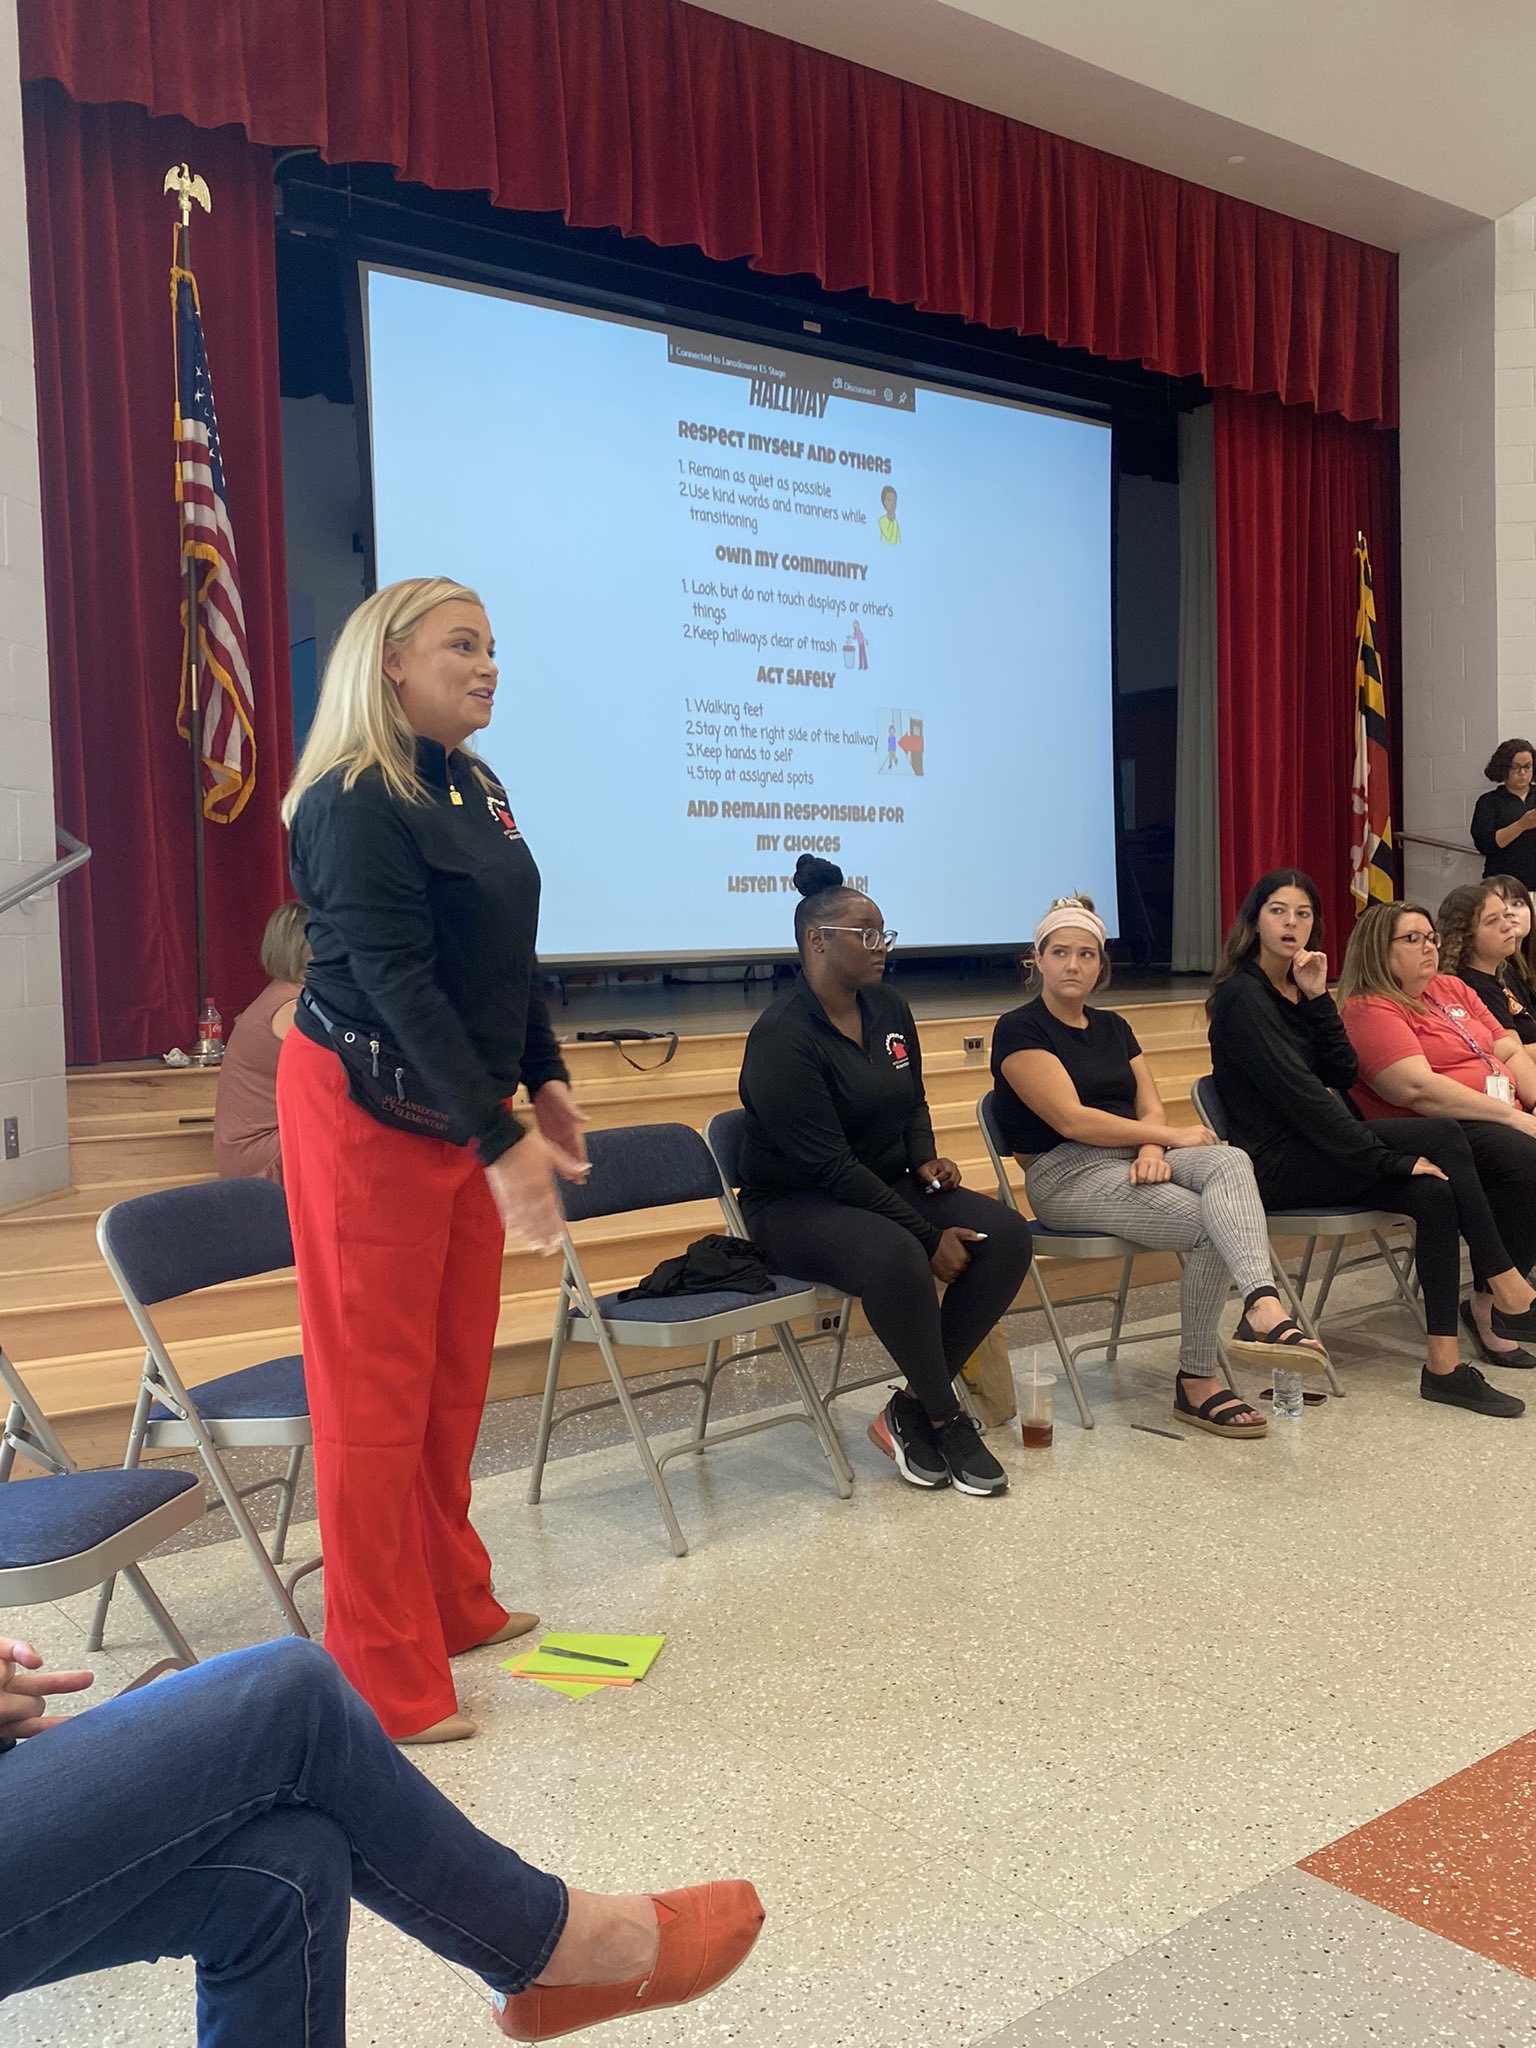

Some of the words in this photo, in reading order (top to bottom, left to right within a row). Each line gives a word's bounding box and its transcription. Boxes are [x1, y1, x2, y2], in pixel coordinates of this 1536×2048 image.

[676, 347, 712, 362] Connected
[714, 355, 721, 364] to
[722, 356, 758, 372] Lansdowne
[759, 364, 767, 374] ES
[768, 366, 786, 379] Stage
[750, 379, 830, 418] HALLWAY
[844, 382, 877, 396] Disconnect
[688, 460, 730, 481] Remain
[733, 470, 745, 484] as
[748, 470, 774, 492] quiet
[777, 478, 790, 492] as
[792, 478, 832, 498] possible
[713, 486, 735, 504] kind
[738, 490, 770, 510] words
[772, 495, 792, 513] and
[794, 501, 839, 521] manners
[841, 506, 867, 524] while
[690, 505, 758, 535] transitioning
[692, 580, 719, 598] Look
[720, 582, 738, 599] but
[742, 586, 754, 601] do
[757, 588, 775, 604] not
[777, 590, 805, 607] touch
[808, 595, 847, 617] displays
[849, 601, 859, 613] or
[862, 601, 894, 617] other's
[692, 602, 727, 625] things
[722, 627, 768, 652] hallways
[771, 633, 794, 648] clear
[797, 636, 809, 652] of
[811, 637, 837, 653] trash
[694, 699, 740, 722] Walking
[743, 702, 763, 717] feet
[724, 725, 737, 737] on
[740, 723, 757, 738] the
[760, 726, 785, 746] right
[788, 727, 808, 742] side
[811, 728, 823, 743] of
[824, 729, 840, 744] the
[842, 730, 879, 752] hallway
[725, 744, 757, 760] hands
[759, 746, 771, 761] to
[774, 747, 793, 763] self
[725, 768, 736, 780] at
[739, 768, 784, 788] assigned
[787, 771, 814, 789] spots
